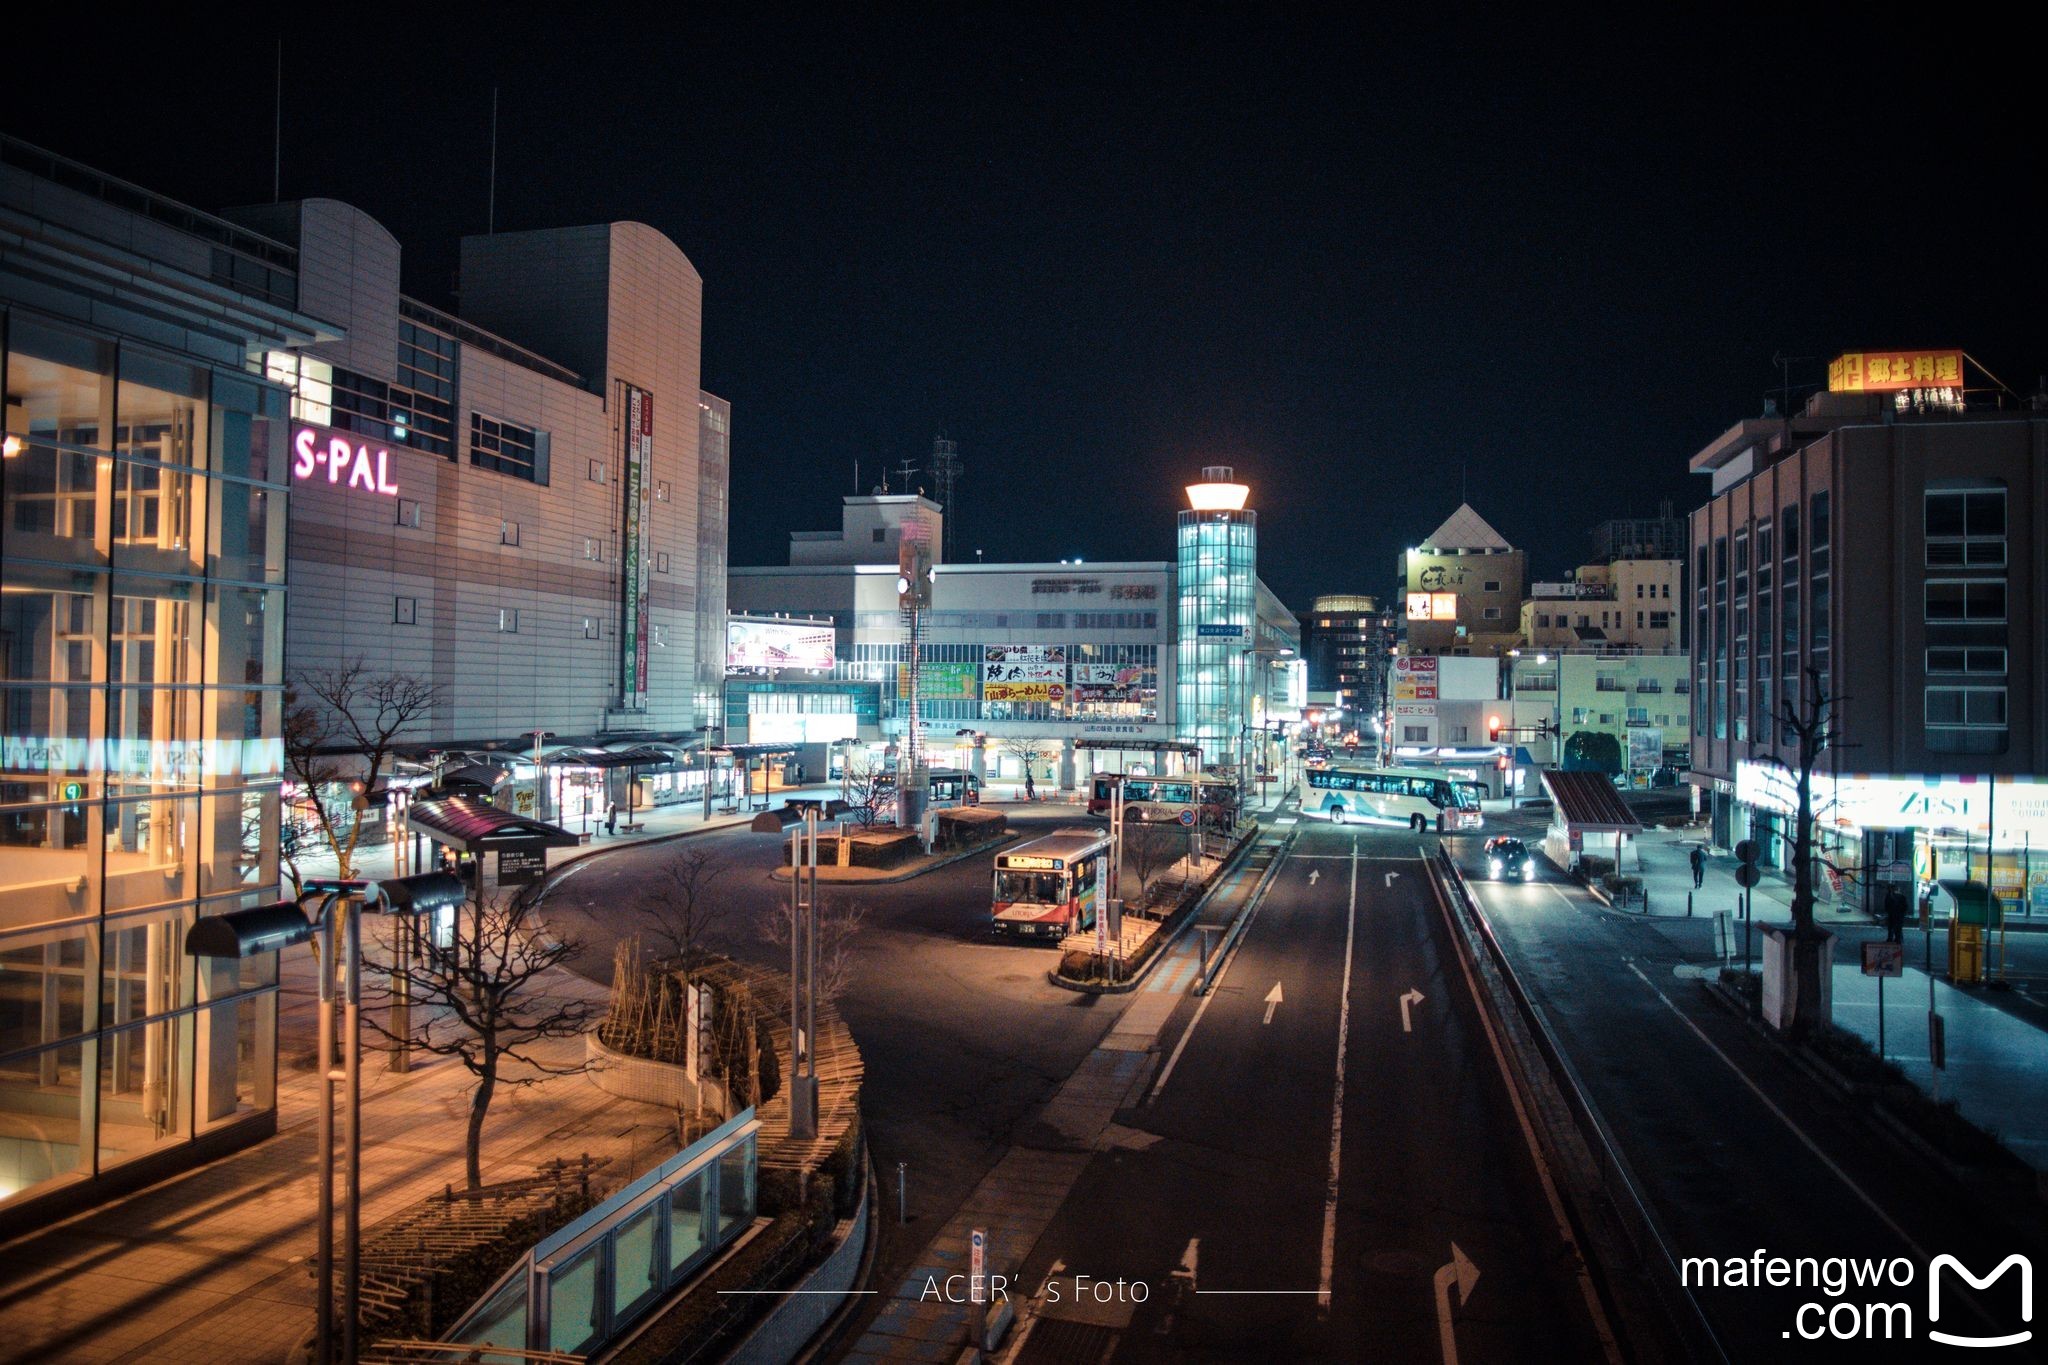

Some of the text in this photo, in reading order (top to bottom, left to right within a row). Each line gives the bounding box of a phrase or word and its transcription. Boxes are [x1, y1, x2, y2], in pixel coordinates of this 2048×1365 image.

[1868, 356, 1959, 383] 郷土料理
[295, 428, 399, 496] S-PAL
